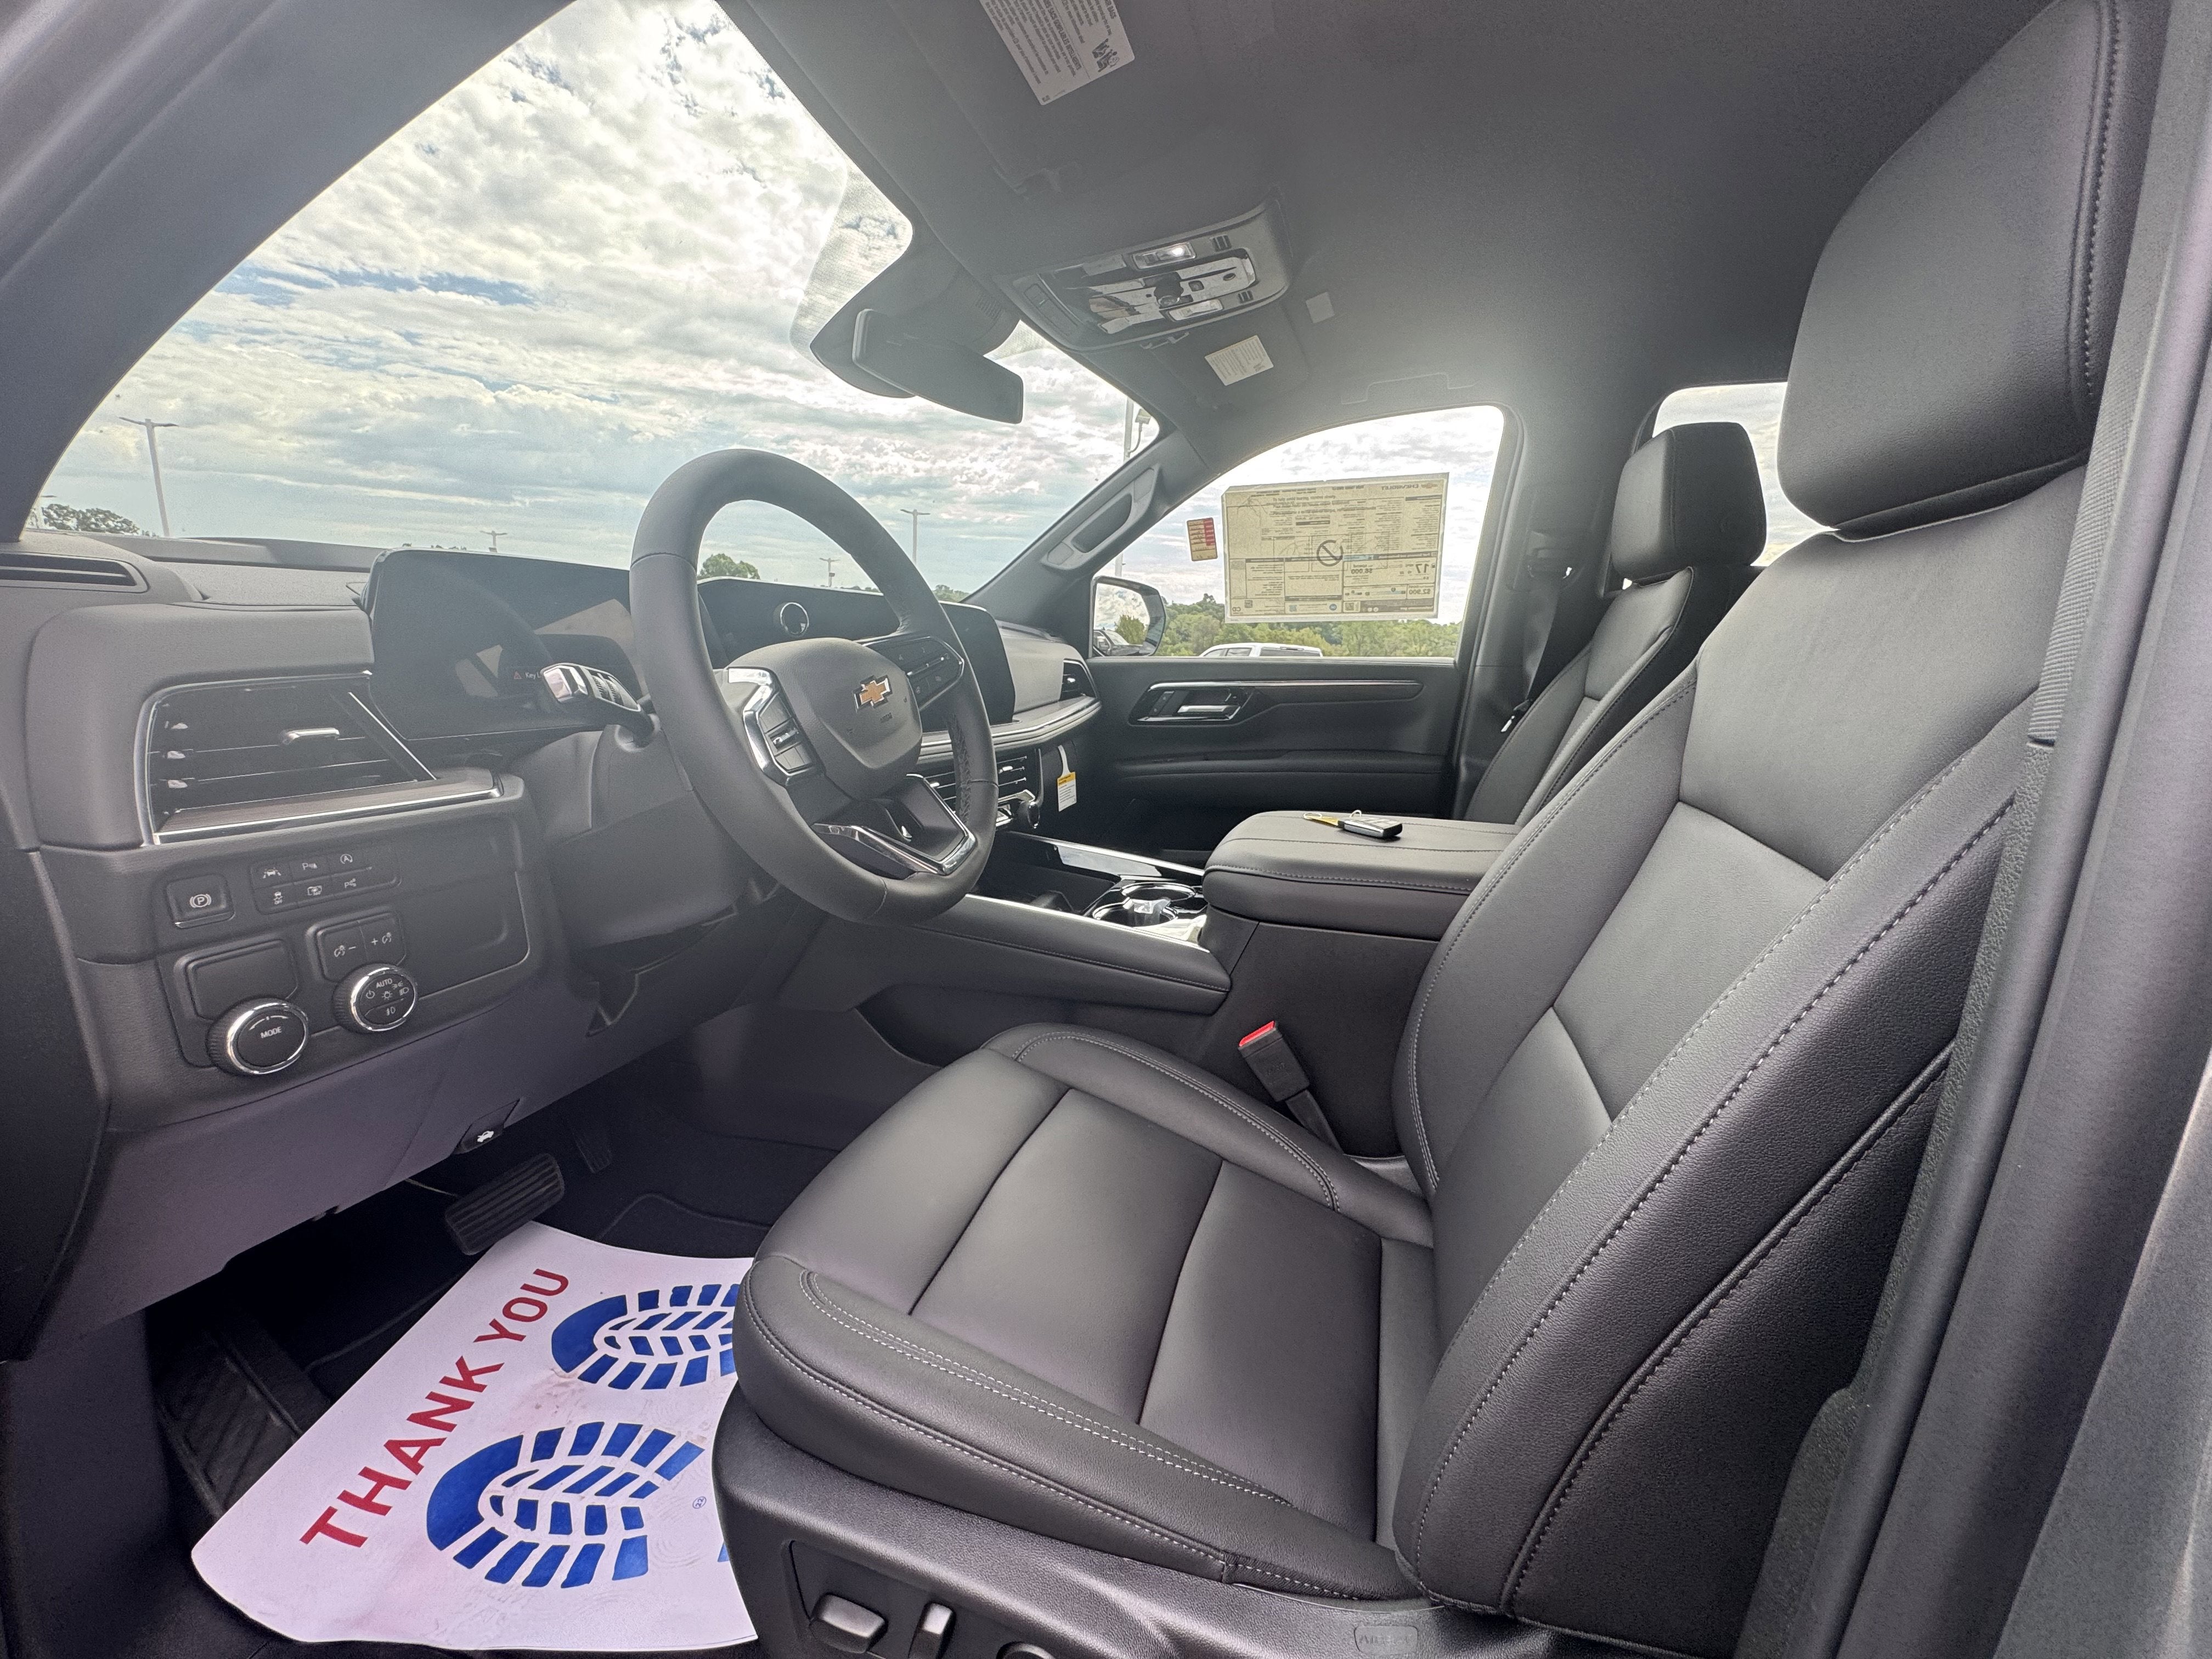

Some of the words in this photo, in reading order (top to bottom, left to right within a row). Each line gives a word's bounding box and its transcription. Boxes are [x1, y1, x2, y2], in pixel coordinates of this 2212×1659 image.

[524, 672, 535, 680] Key
[197, 896, 205, 905] P
[376, 978, 393, 989] AUTO
[260, 1026, 283, 1039] MODE
[299, 1356, 505, 1548] THANK
[473, 1268, 569, 1343] YOU
